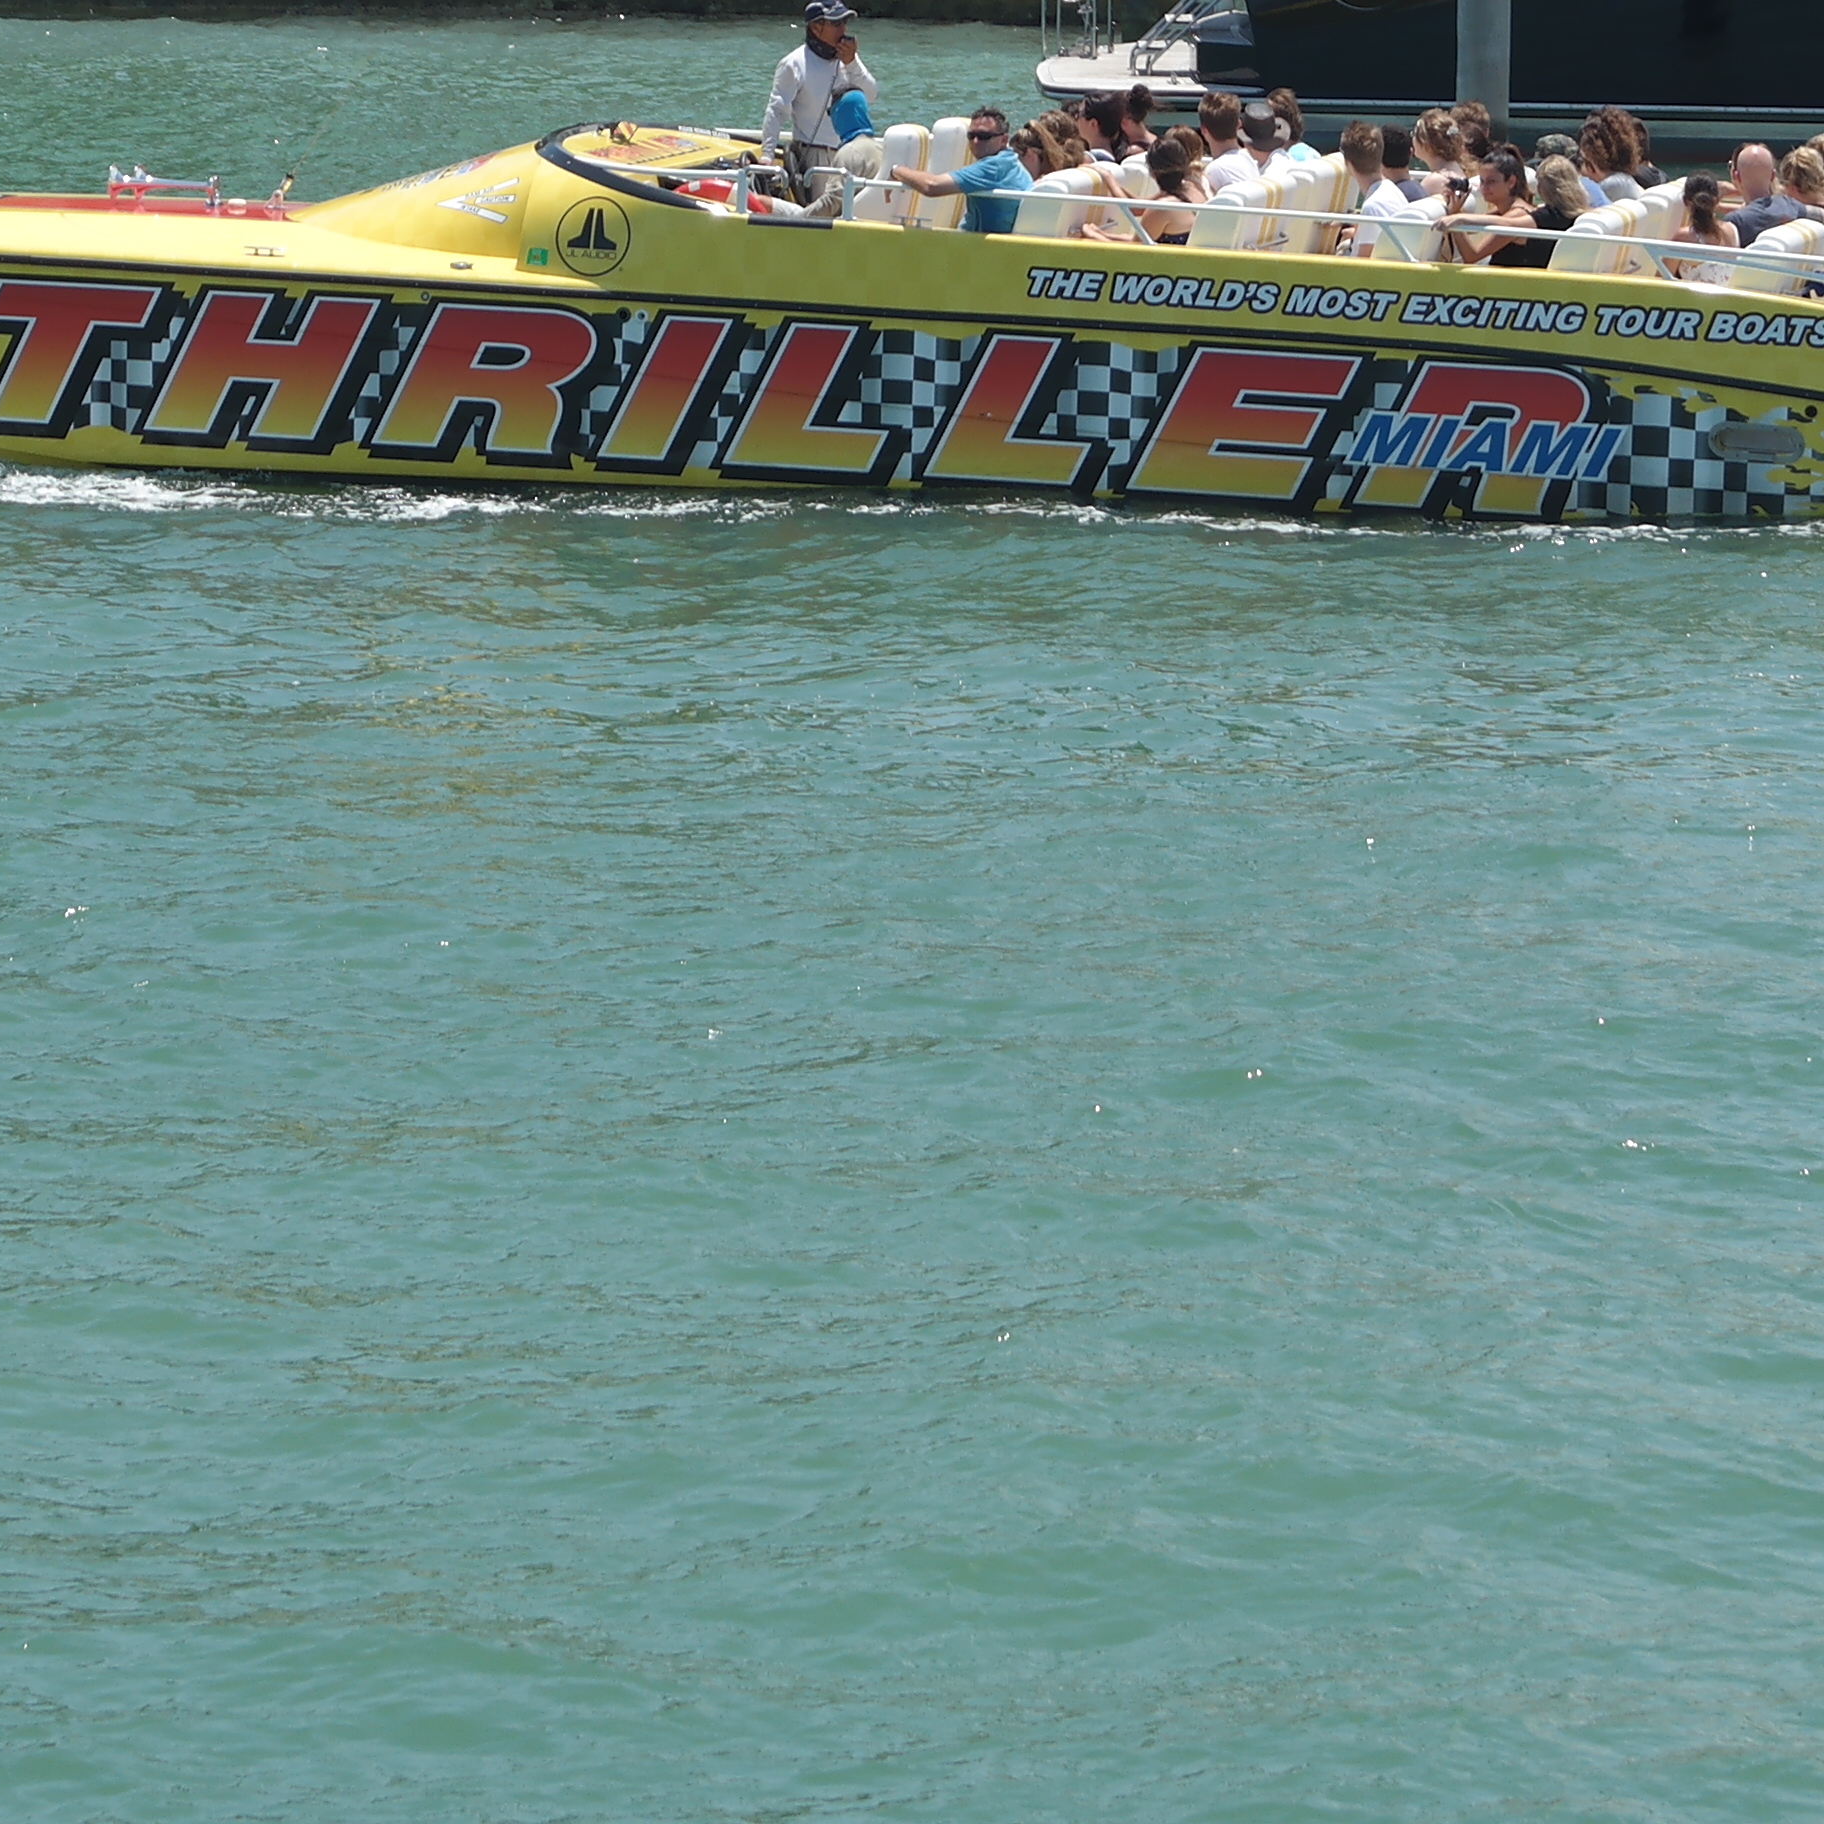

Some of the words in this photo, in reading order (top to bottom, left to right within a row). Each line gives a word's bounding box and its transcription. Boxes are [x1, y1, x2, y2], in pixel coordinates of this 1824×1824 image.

[582, 250, 616, 261] AUDIO
[1027, 268, 1107, 302] THE
[1111, 273, 1279, 313] WORLD'S
[1284, 286, 1399, 322] MOST
[1401, 294, 1584, 333] EXCITING
[1595, 306, 1701, 340] TOUR
[1342, 410, 1634, 483] MIAMI
